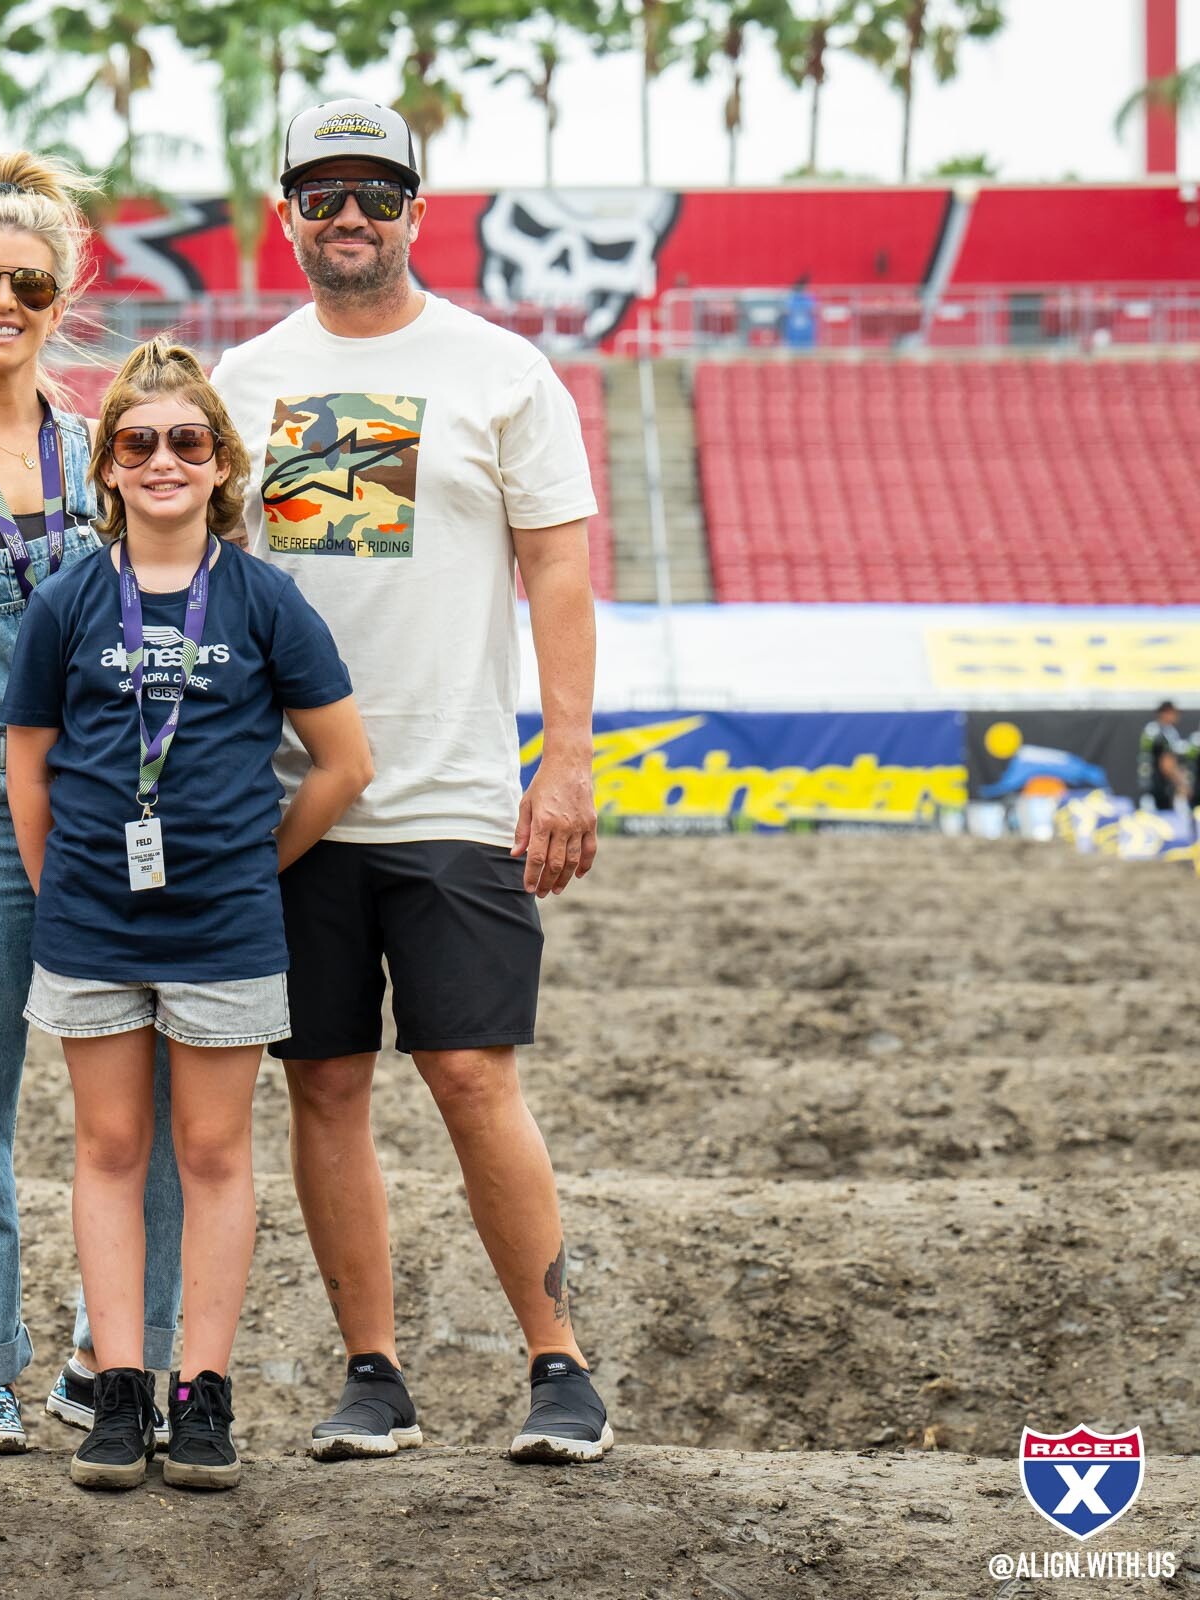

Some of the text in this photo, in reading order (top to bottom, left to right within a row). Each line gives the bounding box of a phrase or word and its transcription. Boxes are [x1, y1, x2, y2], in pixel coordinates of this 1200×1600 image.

[315, 124, 385, 138] MOTORSPORTS
[322, 118, 380, 129] MOUNTAIN
[272, 535, 410, 553] THE FREEDOM OF RIDING
[101, 642, 230, 672] alnesars
[173, 673, 213, 691] CRSE
[136, 838, 152, 847] FELD
